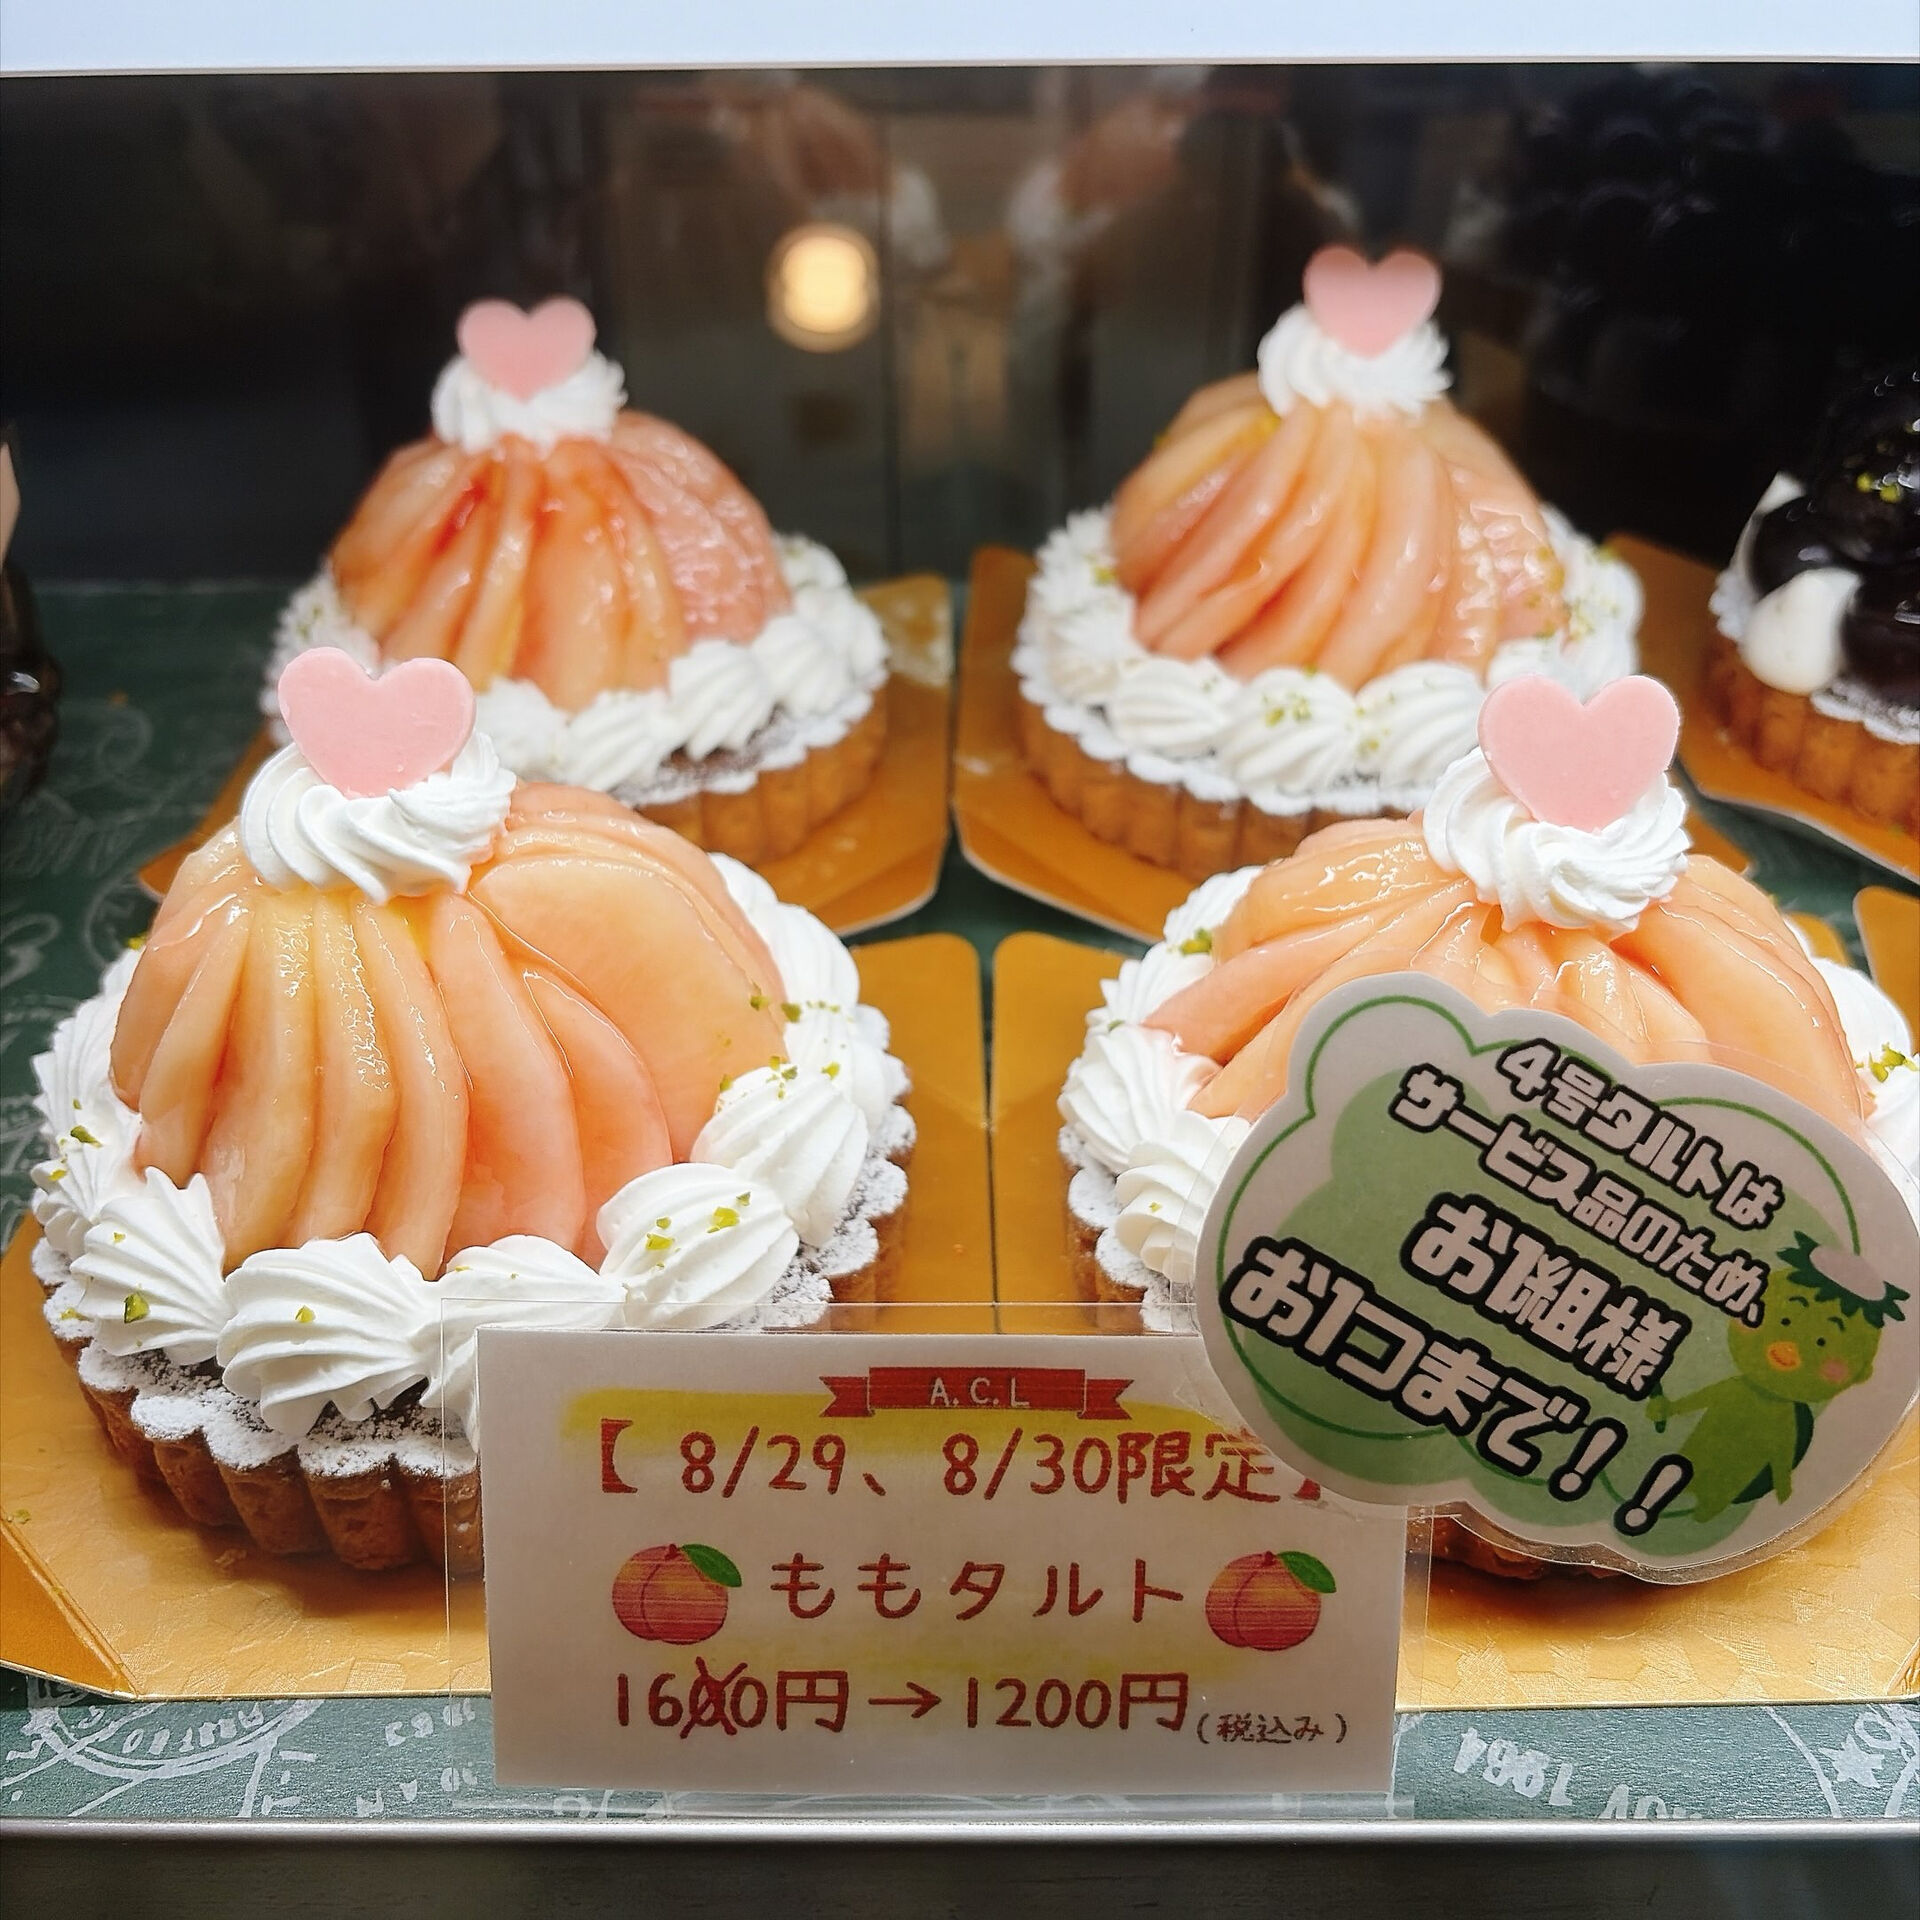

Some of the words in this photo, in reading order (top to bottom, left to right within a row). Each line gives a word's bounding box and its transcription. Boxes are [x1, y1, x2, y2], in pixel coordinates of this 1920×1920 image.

[1388, 1063, 1767, 1328] サービス品のため、
[1497, 1037, 1785, 1230] 4号タルトは
[1400, 1192, 1692, 1400] お1組様
[770, 1553, 1184, 1623] ももタルト
[967, 1672, 1189, 1732] 1200円
[1195, 1712, 1348, 1745] (税込み)
